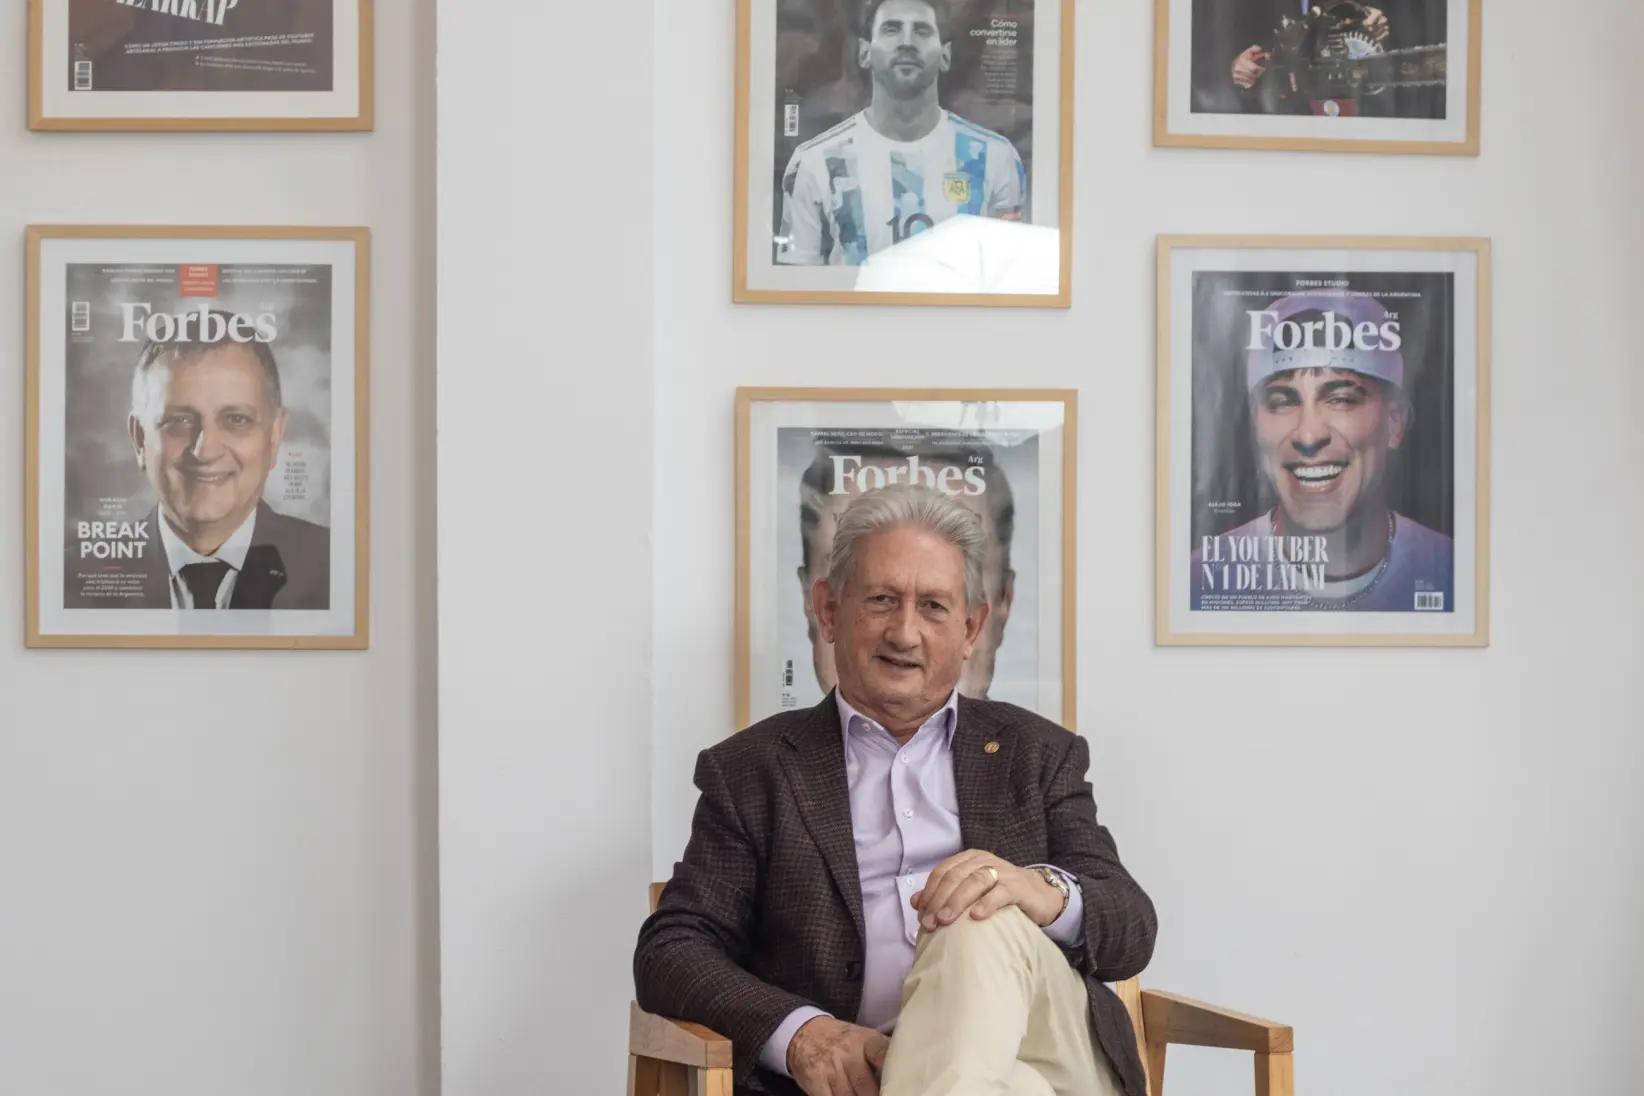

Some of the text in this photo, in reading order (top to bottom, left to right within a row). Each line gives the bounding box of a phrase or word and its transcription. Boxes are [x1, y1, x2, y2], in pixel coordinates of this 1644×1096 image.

[991, 19, 1018, 28] Cómo
[970, 29, 1018, 37] convertirse
[1295, 279, 1323, 287] FORBES
[118, 302, 278, 343] Forbes
[1245, 310, 1402, 351] Forbes
[967, 455, 984, 466] Arg
[828, 455, 987, 495] Forbes
[77, 521, 150, 539] BREAK
[81, 541, 148, 559] POINT
[1201, 535, 1329, 562] EL YOUTUBER
[1235, 563, 1263, 591] DE
[1266, 563, 1326, 591] LATAM
